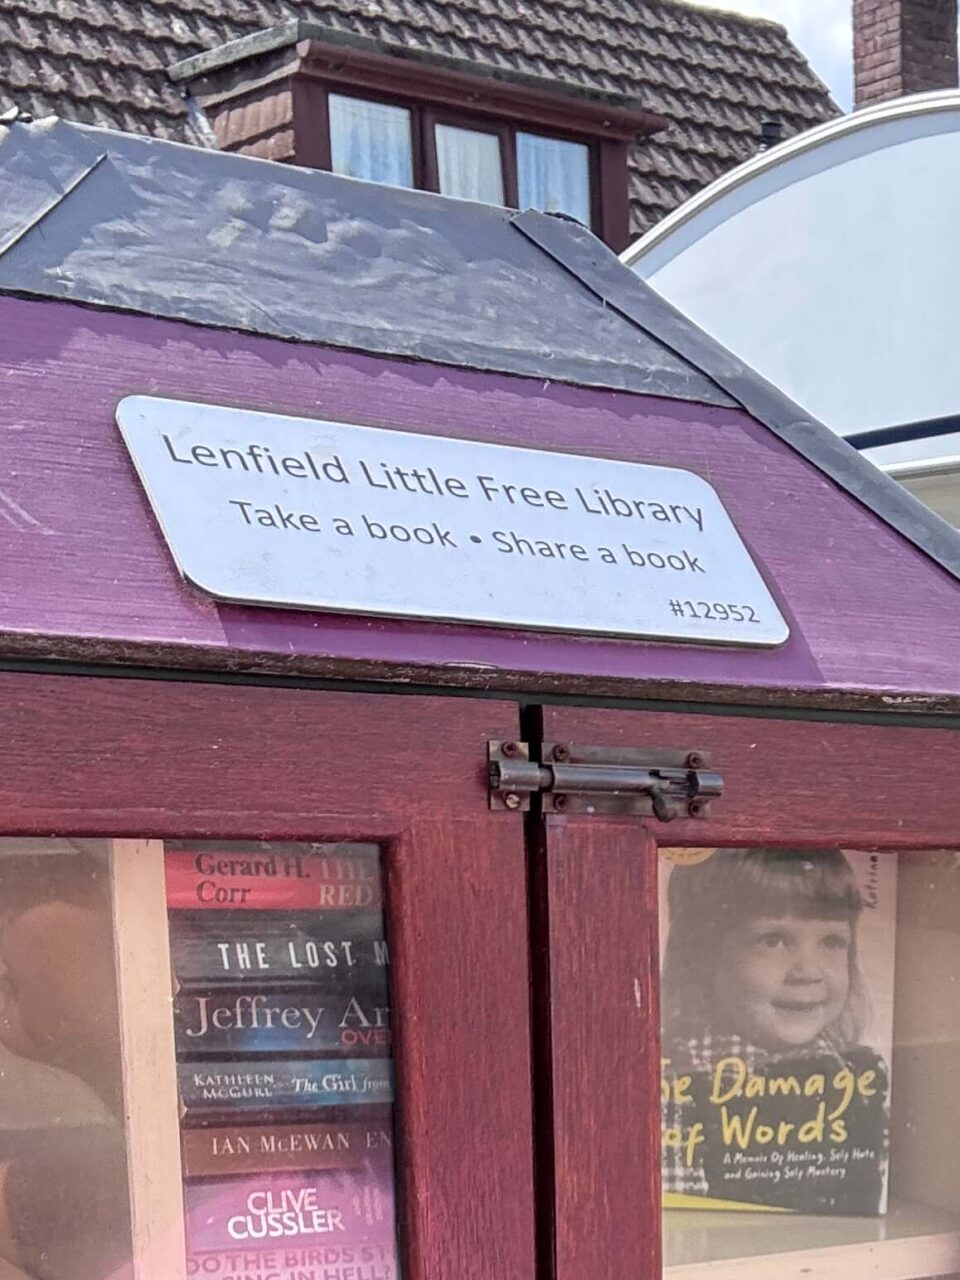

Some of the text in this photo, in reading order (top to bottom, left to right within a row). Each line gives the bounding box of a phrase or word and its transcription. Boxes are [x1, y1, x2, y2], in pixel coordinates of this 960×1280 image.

[163, 434, 704, 531] Lenfield Little Free Library
[229, 500, 707, 574] Take a book Share a book
[669, 598, 760, 624] #12952
[195, 853, 310, 878] Gerard H.
[196, 881, 251, 903] Corr
[217, 943, 270, 970] THE
[288, 941, 356, 968] LOST
[186, 995, 325, 1038] Jeffrey
[291, 1077, 319, 1093] The
[322, 1073, 357, 1092] Girl
[710, 1057, 878, 1120] Damage
[212, 1136, 250, 1156] IAN
[663, 1101, 848, 1167] of Words
[247, 1187, 319, 1216] CLIVE
[227, 1209, 346, 1240] CUSSLER
[225, 1252, 278, 1273] THE
[284, 1247, 356, 1269] BIRDS
